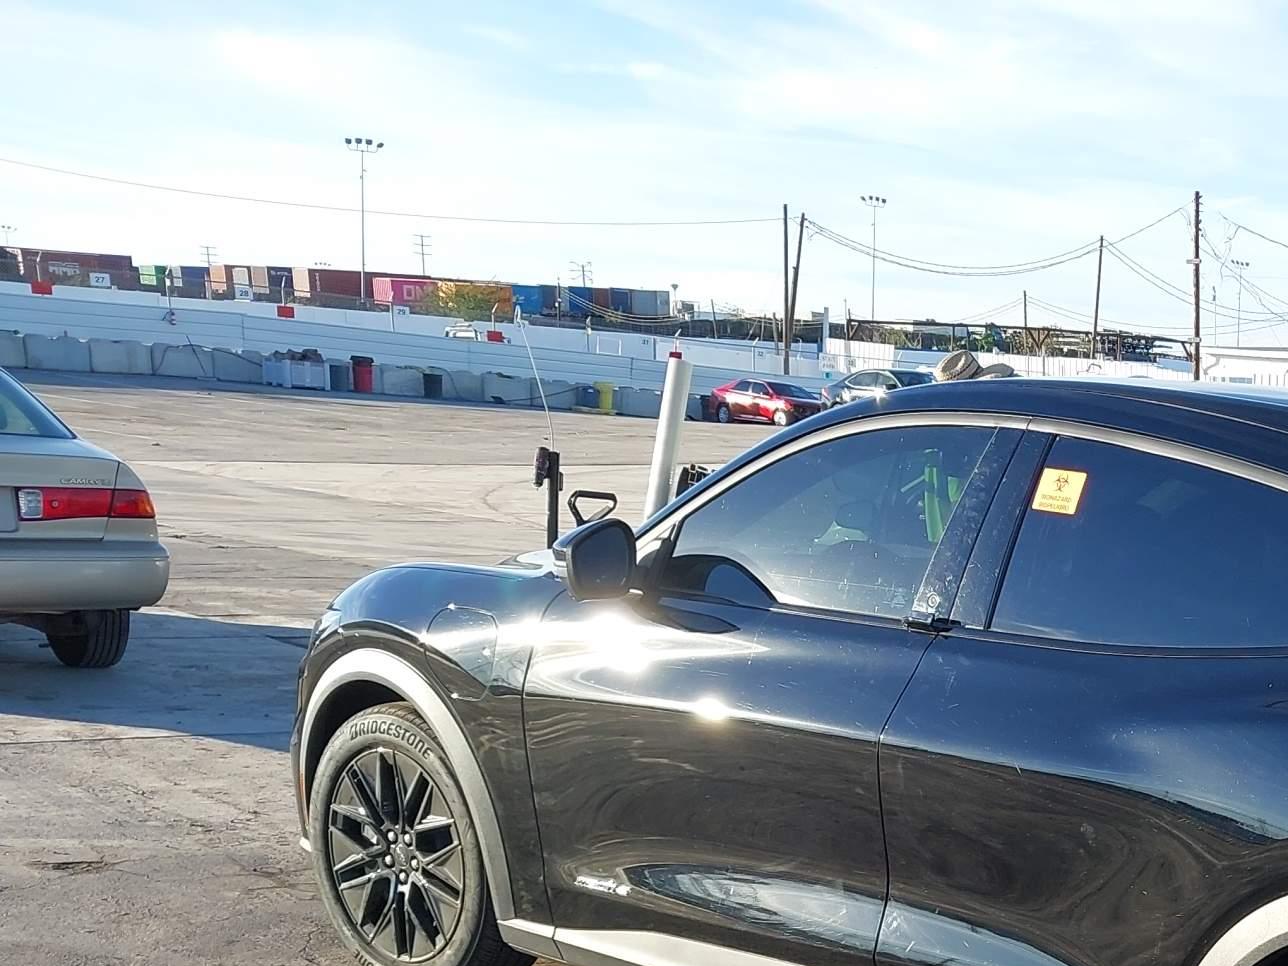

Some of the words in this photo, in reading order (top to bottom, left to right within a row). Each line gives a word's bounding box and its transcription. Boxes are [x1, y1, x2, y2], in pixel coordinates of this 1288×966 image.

[94, 276, 105, 284] 27
[239, 289, 249, 297] 28
[350, 720, 433, 760] BRIDGESTONE
